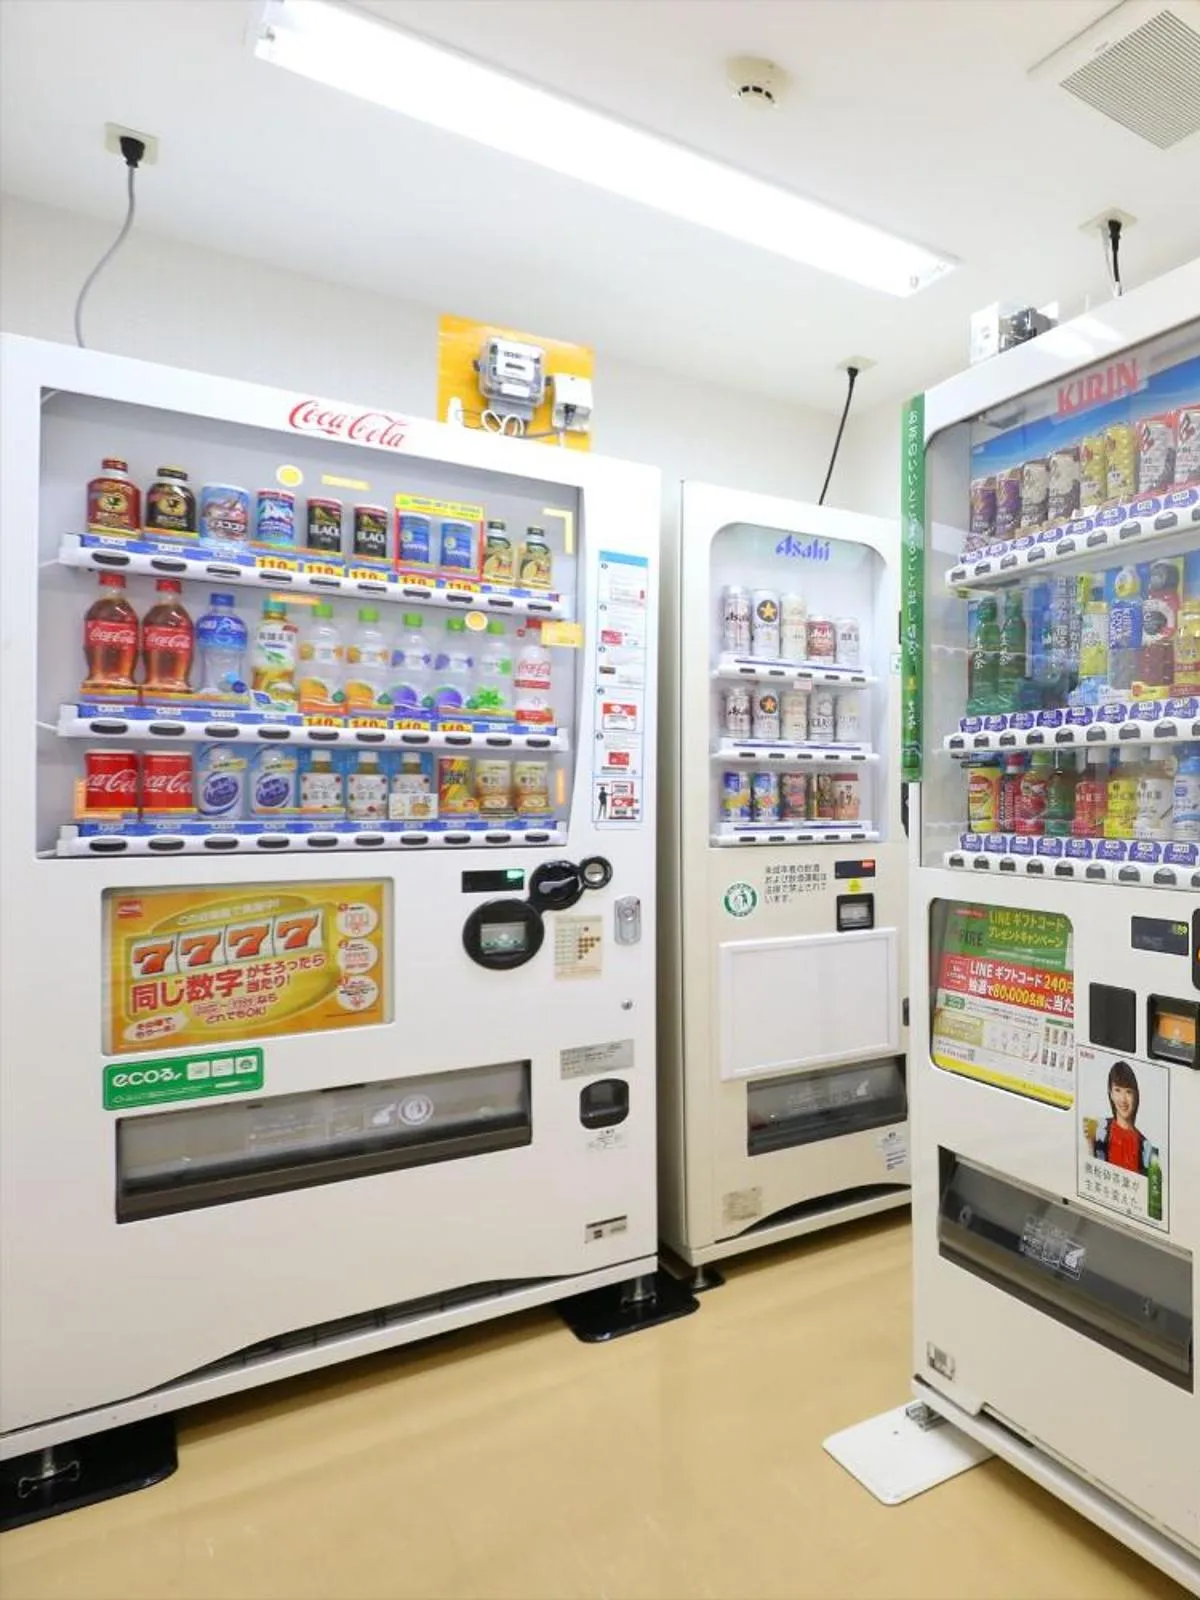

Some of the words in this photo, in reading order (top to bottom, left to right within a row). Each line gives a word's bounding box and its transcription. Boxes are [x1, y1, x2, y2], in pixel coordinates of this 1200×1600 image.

[1057, 359, 1140, 415] KIRIN
[775, 534, 830, 562] Asahi
[988, 910, 1011, 927] LINE
[1013, 913, 1067, 932] ギフトコード
[988, 926, 1064, 947] プレゼントキャンペーン
[132, 967, 244, 1014] 同じ数字
[247, 953, 326, 977] がそろったら
[247, 975, 291, 994] 当たり!
[969, 962, 994, 978] LINE
[995, 968, 1043, 985] ギフトコード
